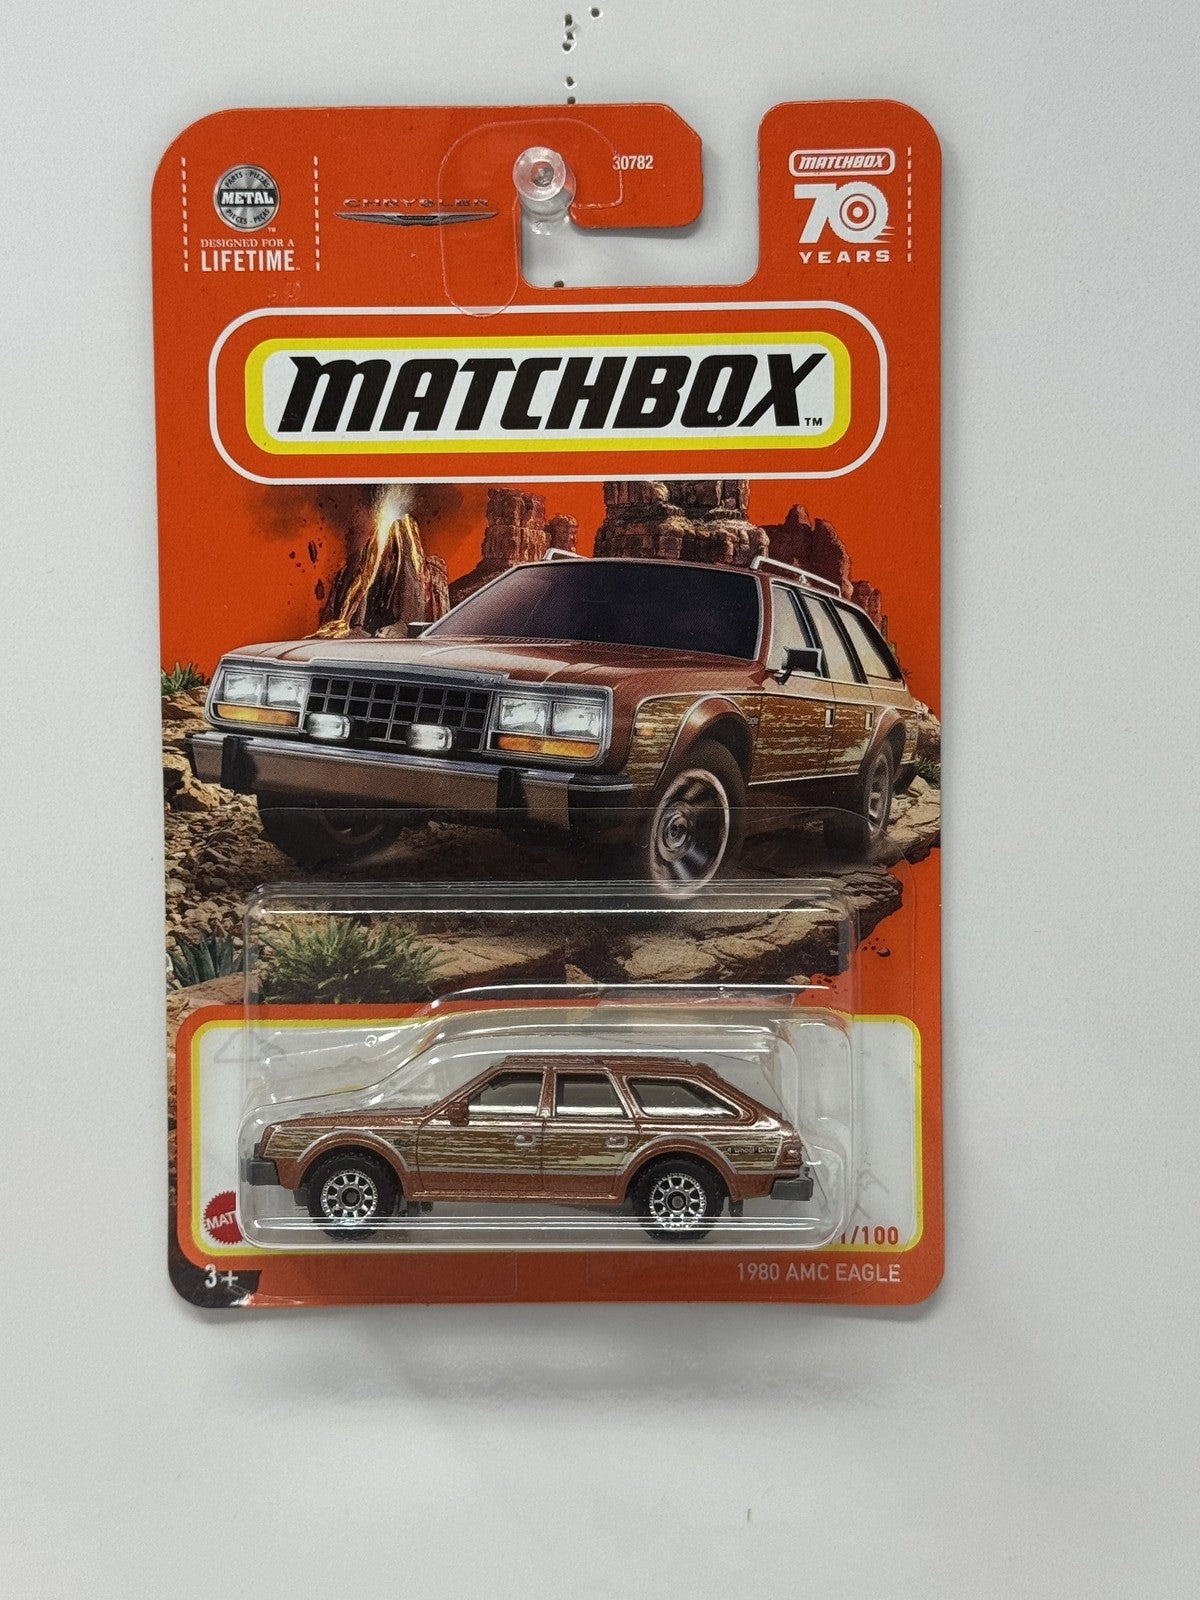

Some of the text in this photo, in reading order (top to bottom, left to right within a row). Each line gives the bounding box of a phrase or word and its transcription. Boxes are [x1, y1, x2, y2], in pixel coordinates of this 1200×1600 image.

[612, 154, 654, 170] 30782
[798, 154, 888, 170] MATCHBOX
[225, 171, 243, 188] PARTS
[221, 191, 275, 205] METAL
[342, 198, 490, 208] CHRYSLER
[794, 181, 893, 244] 70
[201, 238, 295, 248] DESIGNED FOR A
[200, 249, 295, 272] LIFETIME
[799, 249, 891, 264] YEARS
[277, 352, 827, 433] MATCHBOX
[205, 1210, 237, 1230] MAT
[834, 1225, 899, 1245] 1/100
[204, 1263, 239, 1288] 3+
[737, 1262, 901, 1283] 1980 AMC EAGLE
